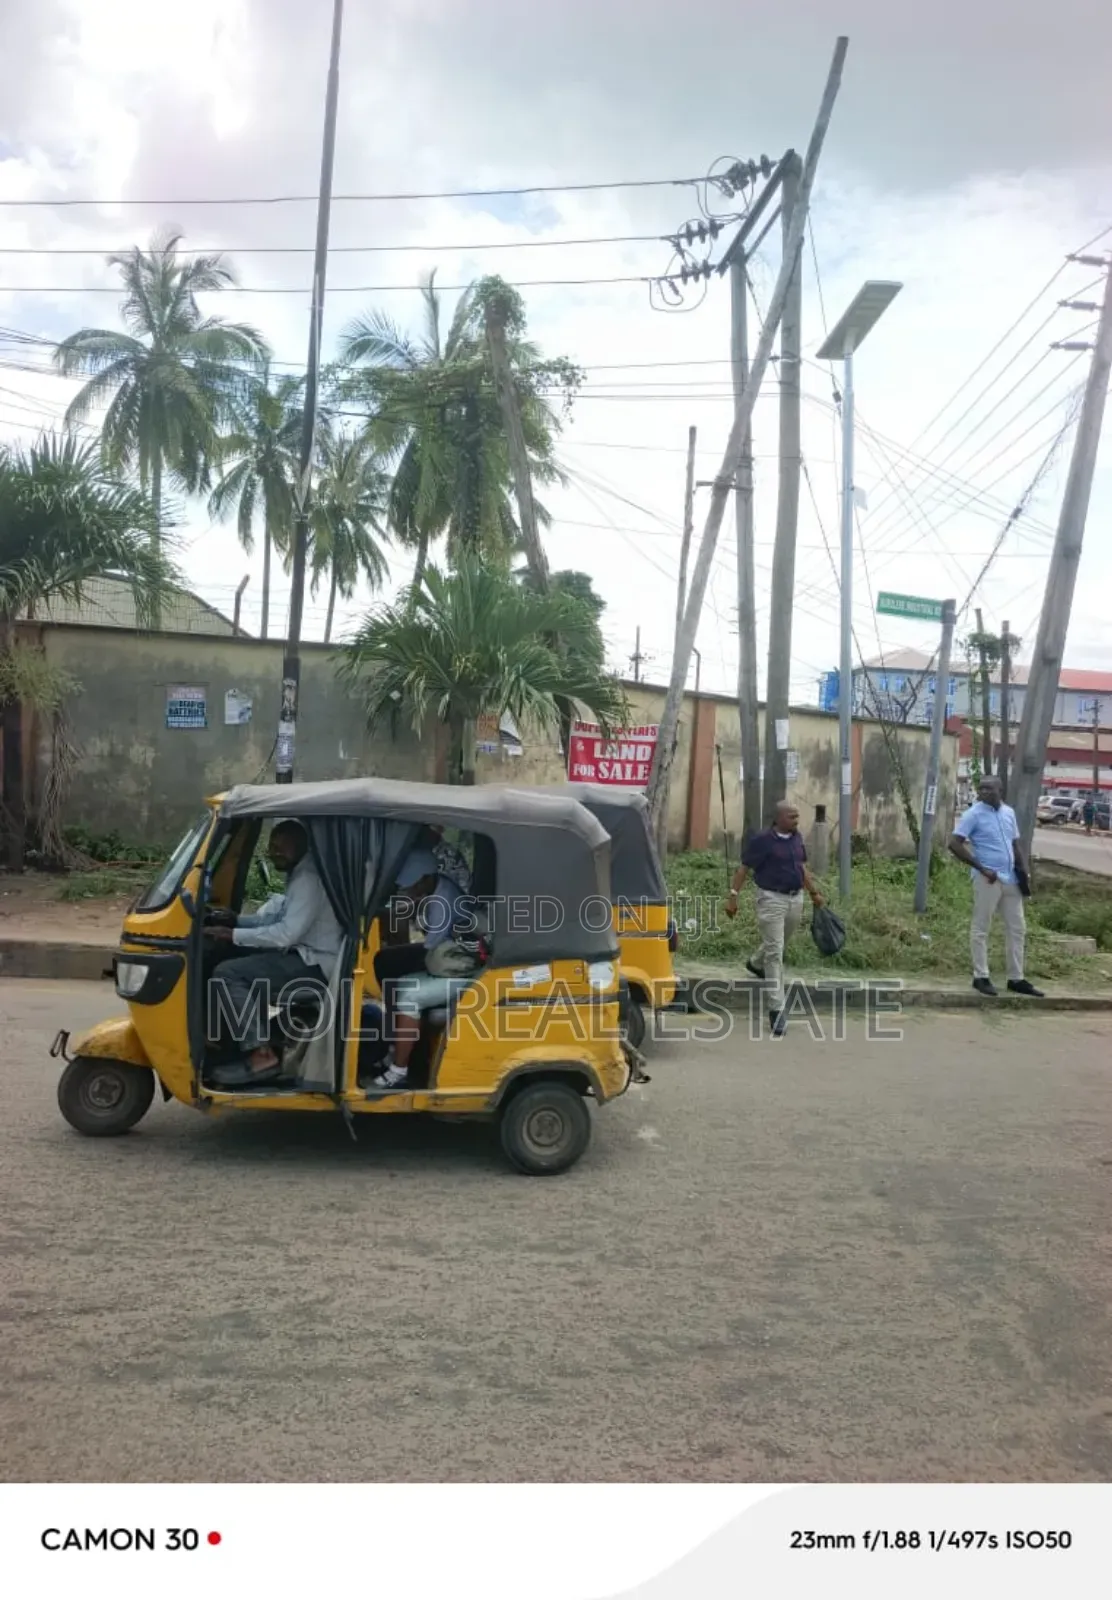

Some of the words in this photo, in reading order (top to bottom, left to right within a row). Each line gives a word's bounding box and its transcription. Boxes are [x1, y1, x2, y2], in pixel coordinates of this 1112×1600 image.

[594, 741, 652, 761] LAND
[573, 763, 595, 777] FOR
[598, 761, 650, 780] SALE
